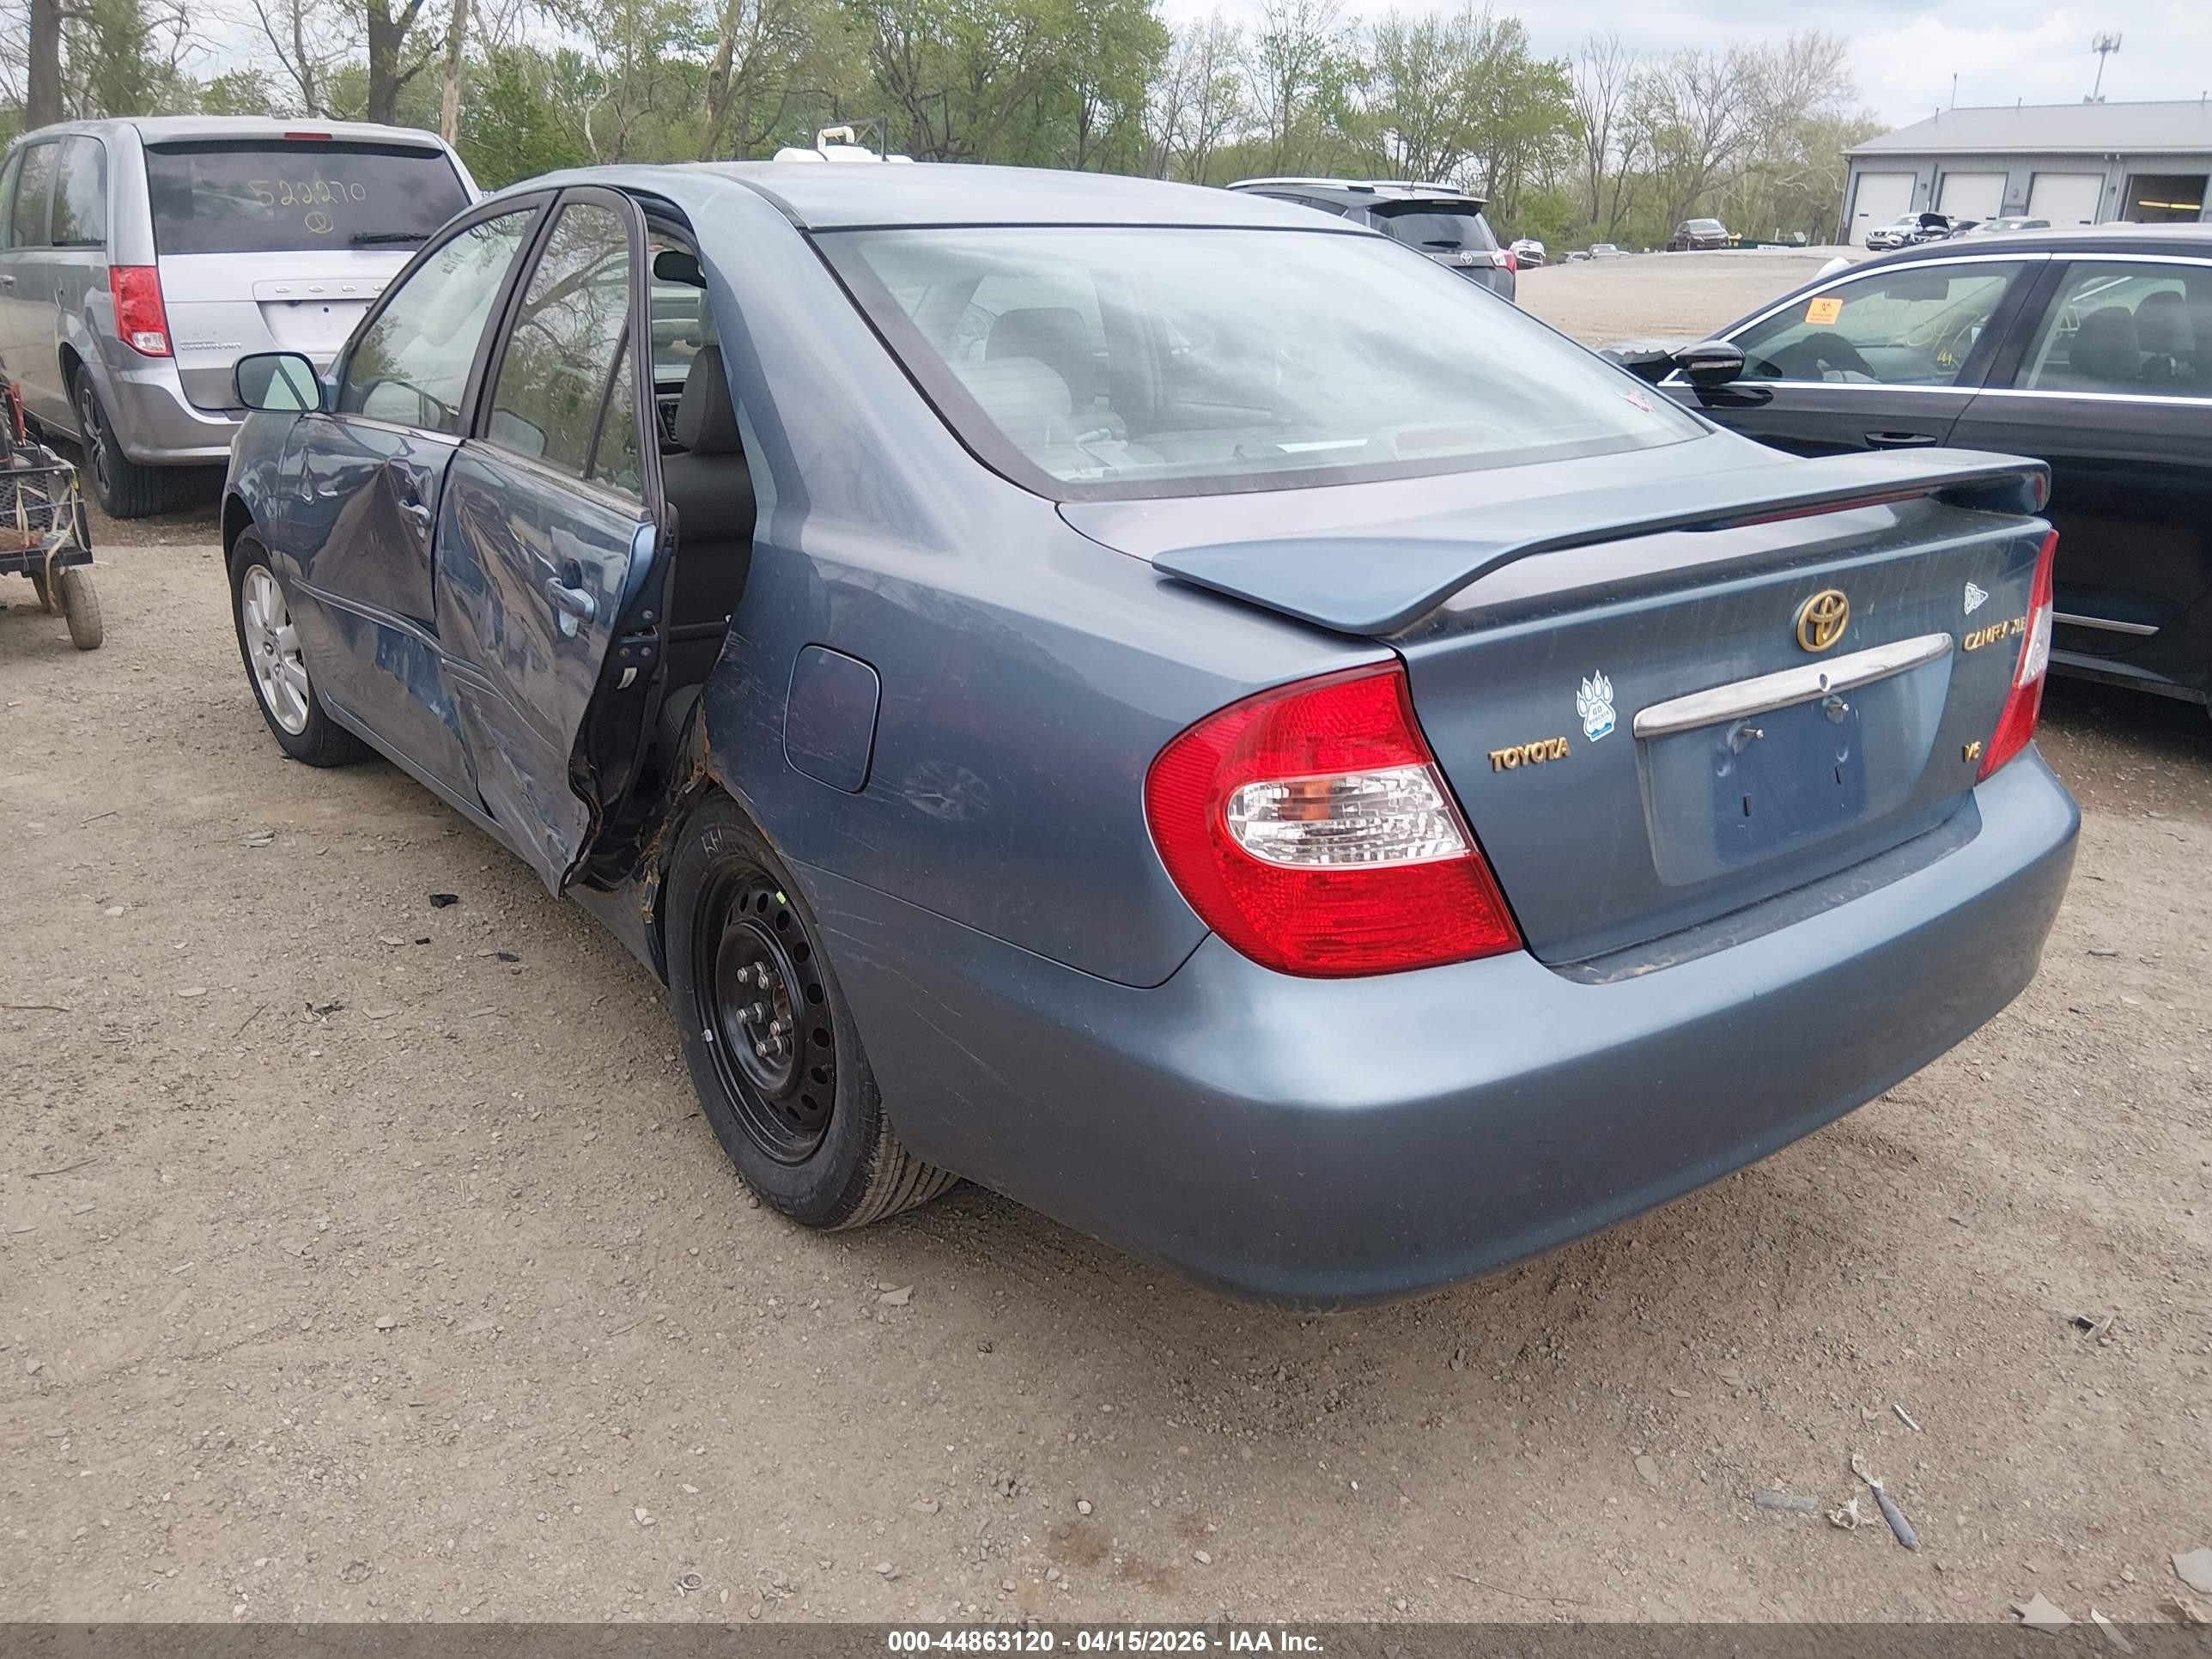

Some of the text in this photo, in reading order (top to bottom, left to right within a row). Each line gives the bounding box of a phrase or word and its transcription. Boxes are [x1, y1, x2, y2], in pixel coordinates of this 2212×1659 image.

[248, 180, 366, 207] 522270
[1962, 619, 2008, 651] CAMRY
[1488, 736, 1571, 772] TOYOTA
[1962, 741, 1982, 763] V6
